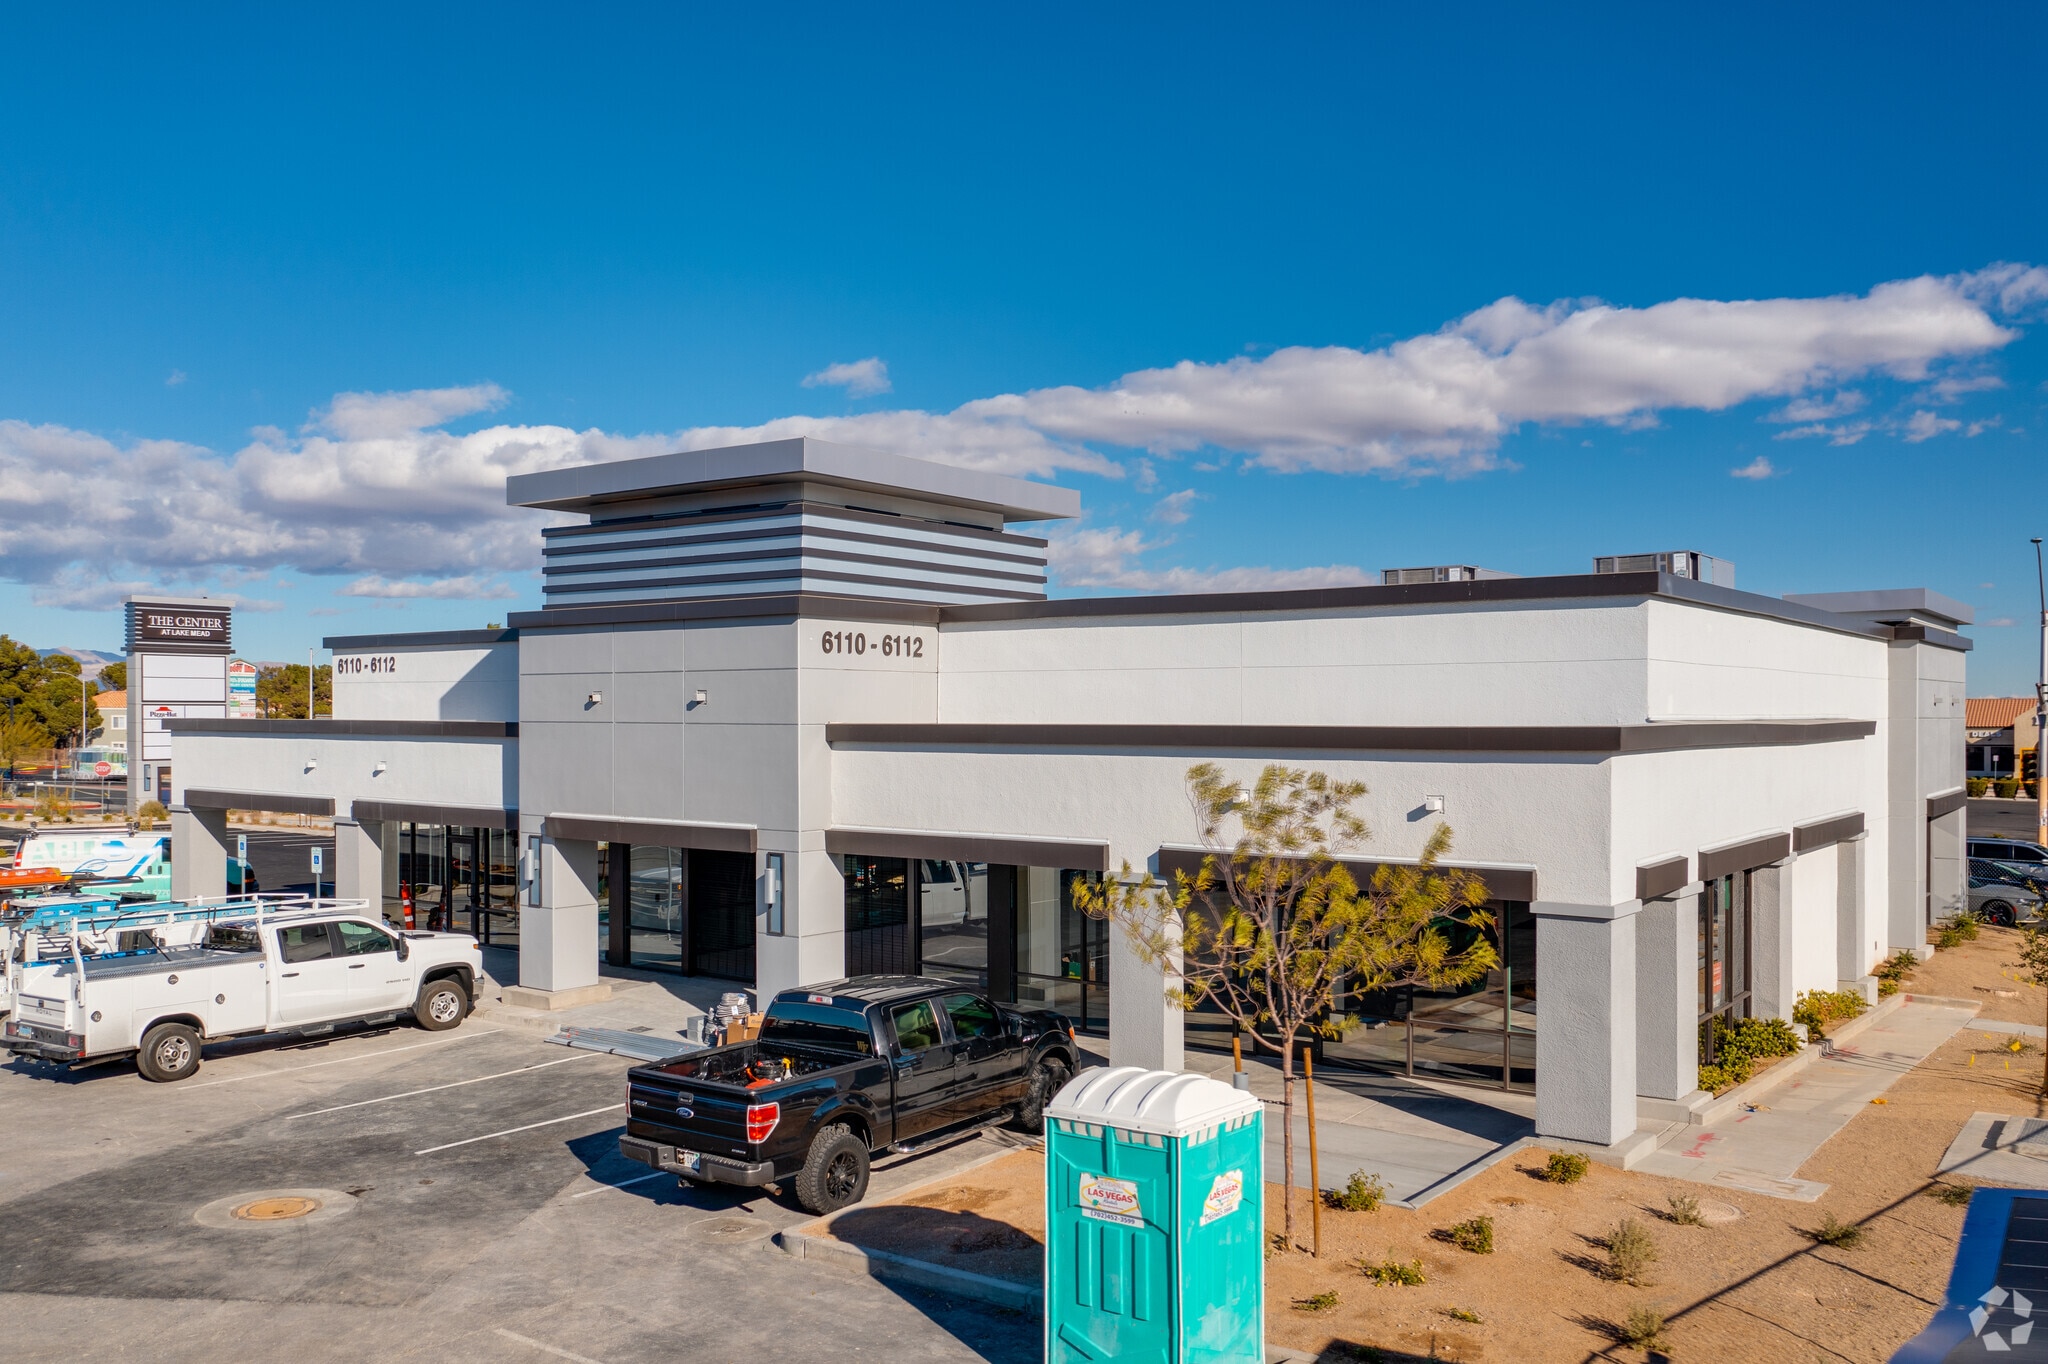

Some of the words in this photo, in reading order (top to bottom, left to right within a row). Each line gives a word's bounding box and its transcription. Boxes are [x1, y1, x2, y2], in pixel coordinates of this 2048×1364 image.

[148, 615, 174, 626] THE
[175, 616, 222, 628] CENTER
[172, 629, 190, 637] LAKE
[95, 765, 111, 773] STOP
[1087, 1187, 1104, 1198] LAS
[1105, 1191, 1133, 1204] VEGAS
[1210, 1191, 1221, 1201] LAS
